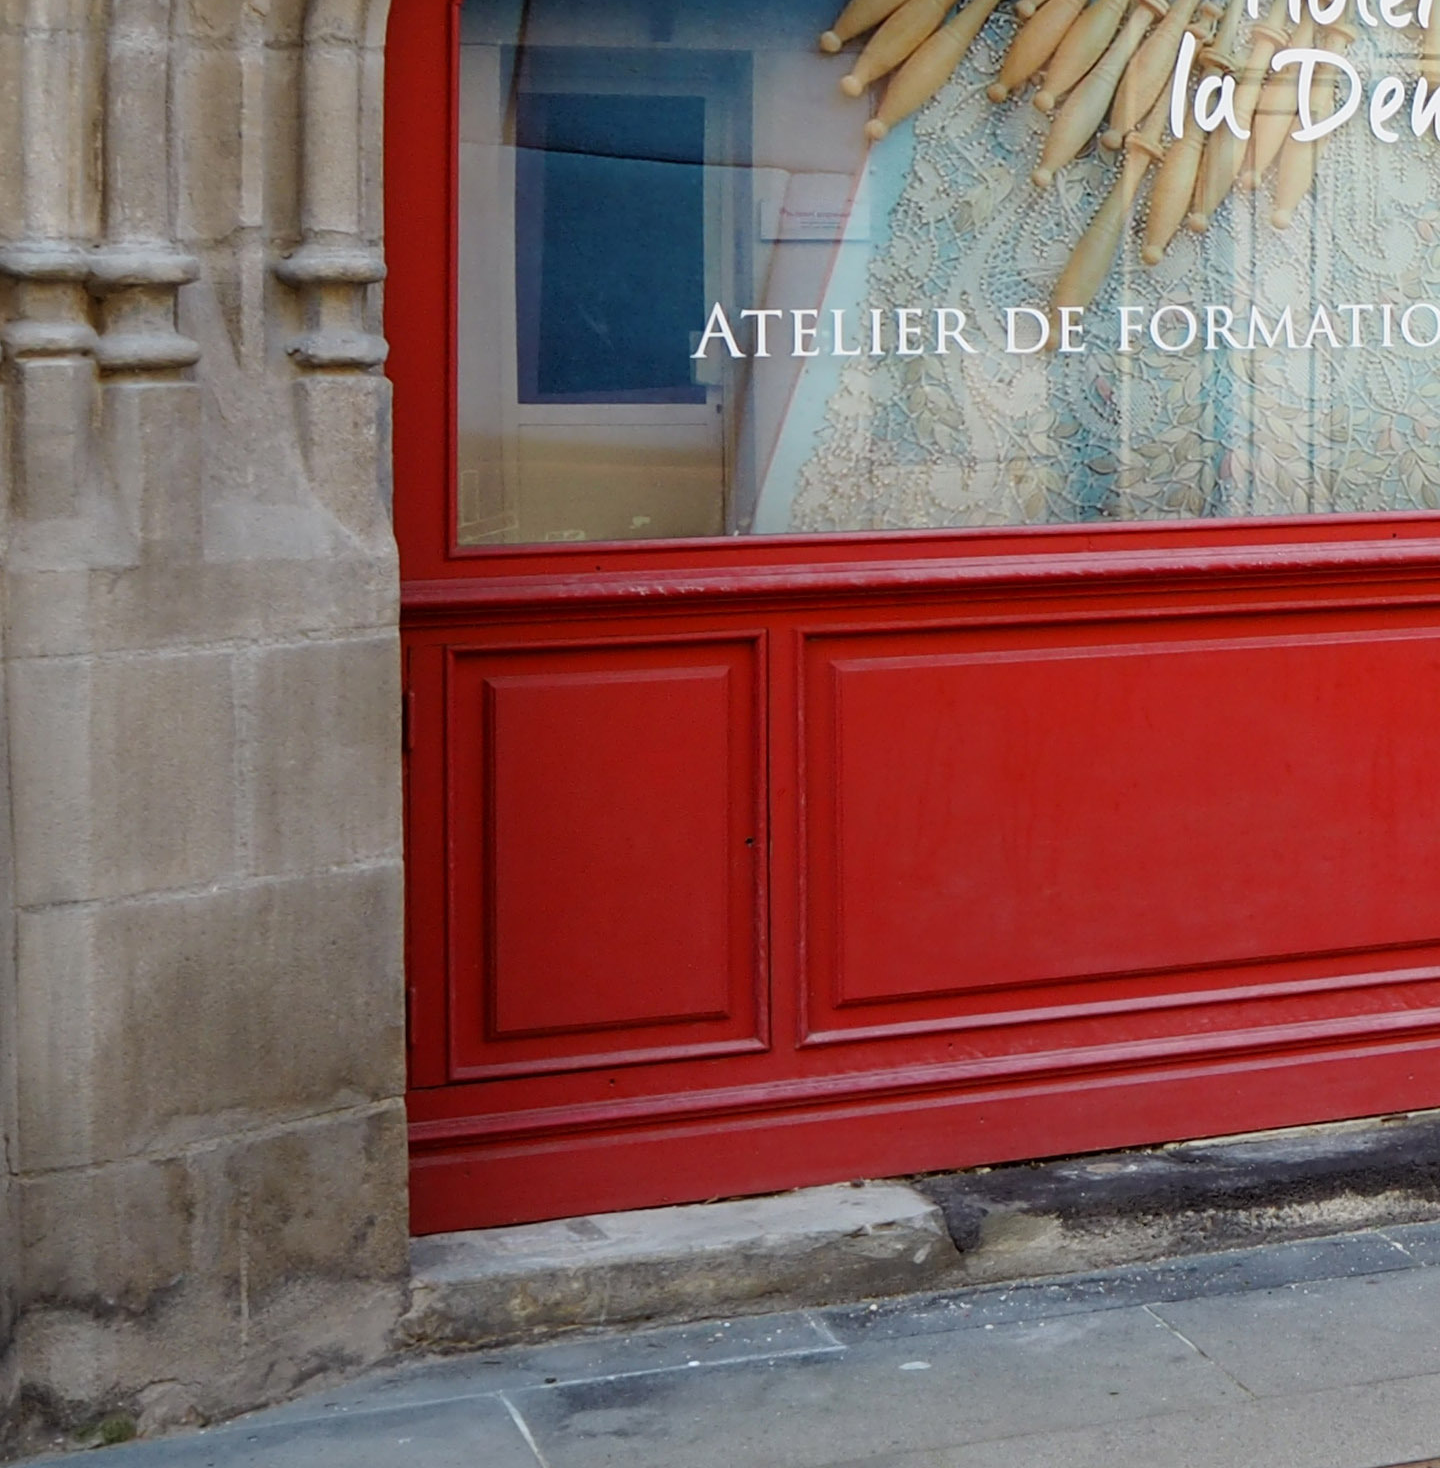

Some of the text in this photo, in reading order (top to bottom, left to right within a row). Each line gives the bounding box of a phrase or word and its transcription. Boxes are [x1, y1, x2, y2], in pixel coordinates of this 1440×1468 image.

[1170, 32, 1251, 140] la
[691, 301, 977, 358] ATELIER
[1004, 306, 1085, 354] DE
